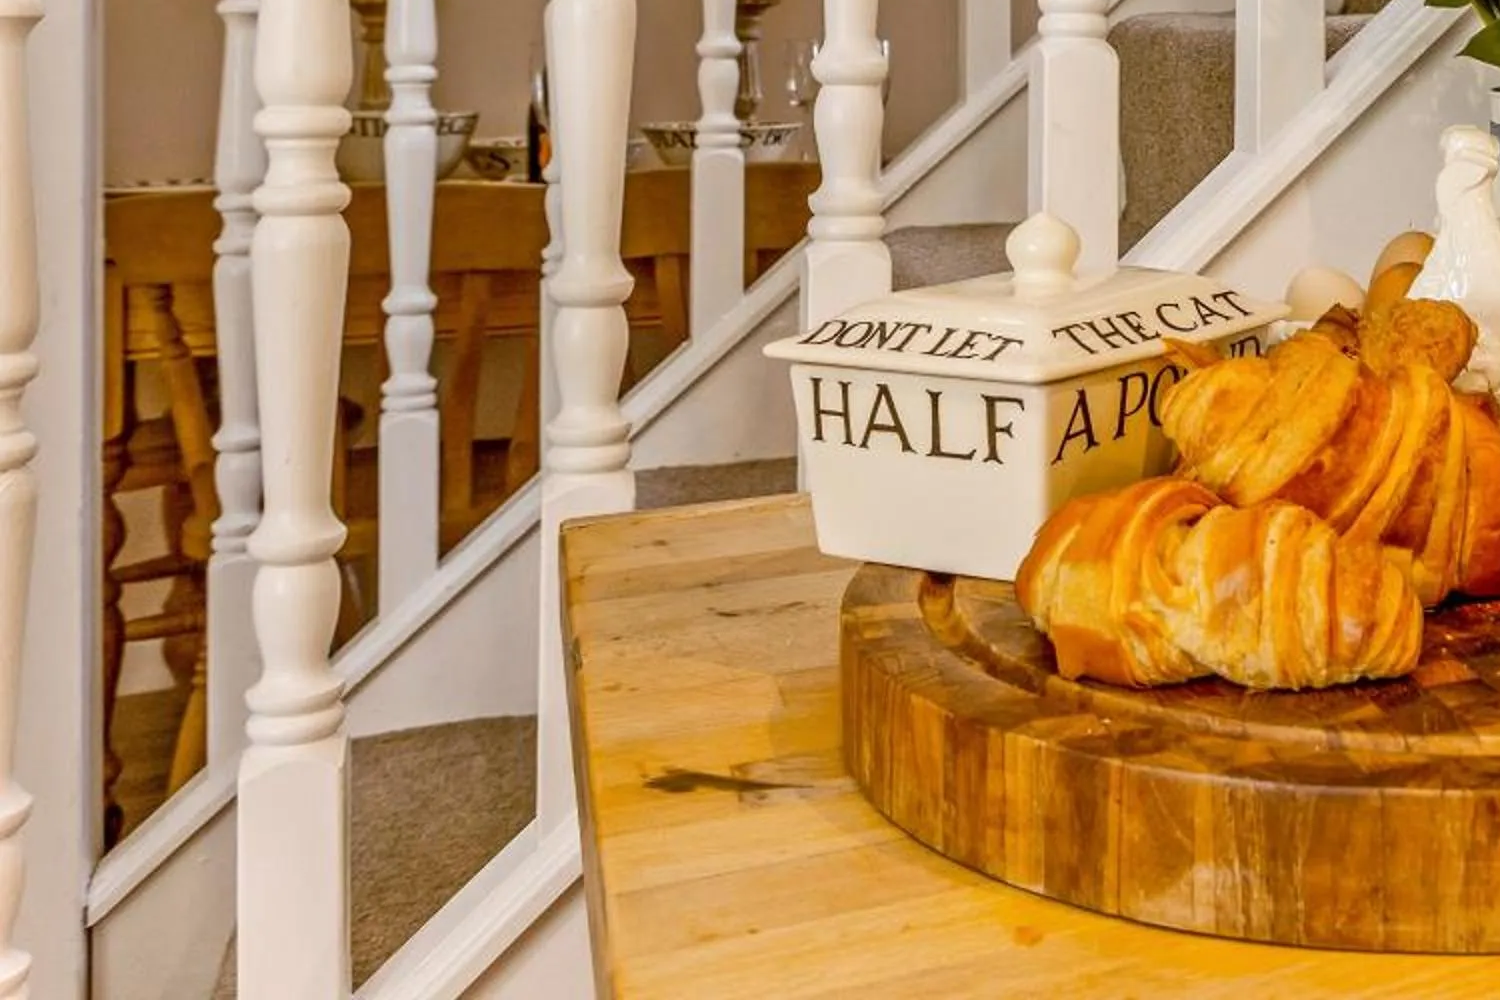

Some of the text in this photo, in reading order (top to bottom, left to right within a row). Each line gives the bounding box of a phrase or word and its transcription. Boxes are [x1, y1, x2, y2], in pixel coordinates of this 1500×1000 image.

[797, 318, 1026, 362] DONT LET
[1051, 289, 1255, 355] THE CAT
[809, 377, 1025, 465] HALF
[1050, 387, 1100, 466] A
